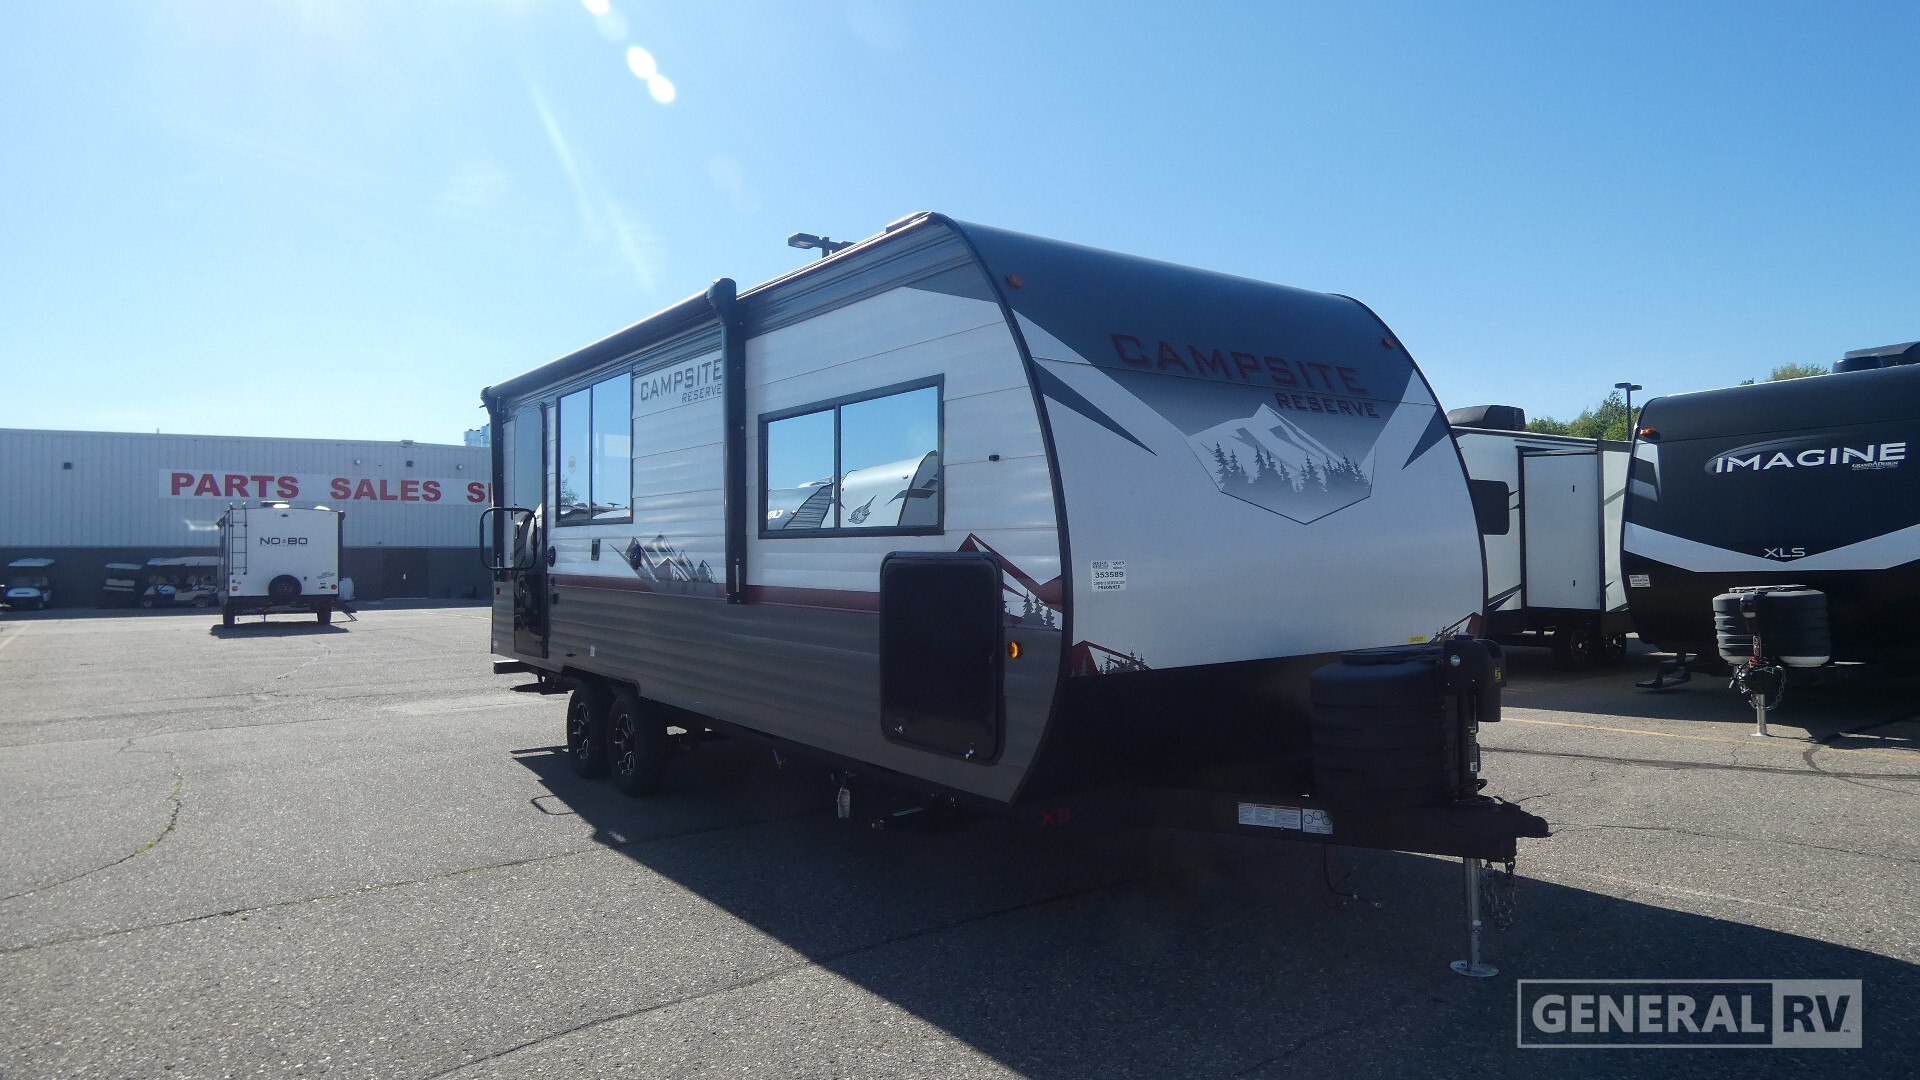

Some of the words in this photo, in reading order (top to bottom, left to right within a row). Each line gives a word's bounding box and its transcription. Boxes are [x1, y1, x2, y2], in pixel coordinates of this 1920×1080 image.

[1111, 333, 1367, 393] CAMPSITE
[640, 358, 722, 401] CAMPSITE
[681, 384, 722, 403] RESERVE
[1274, 393, 1380, 418] RESERVE
[1715, 442, 1906, 473] IMAGINE
[171, 472, 299, 498] PARTS
[330, 477, 442, 502] SALES
[1764, 547, 1806, 558] XLS
